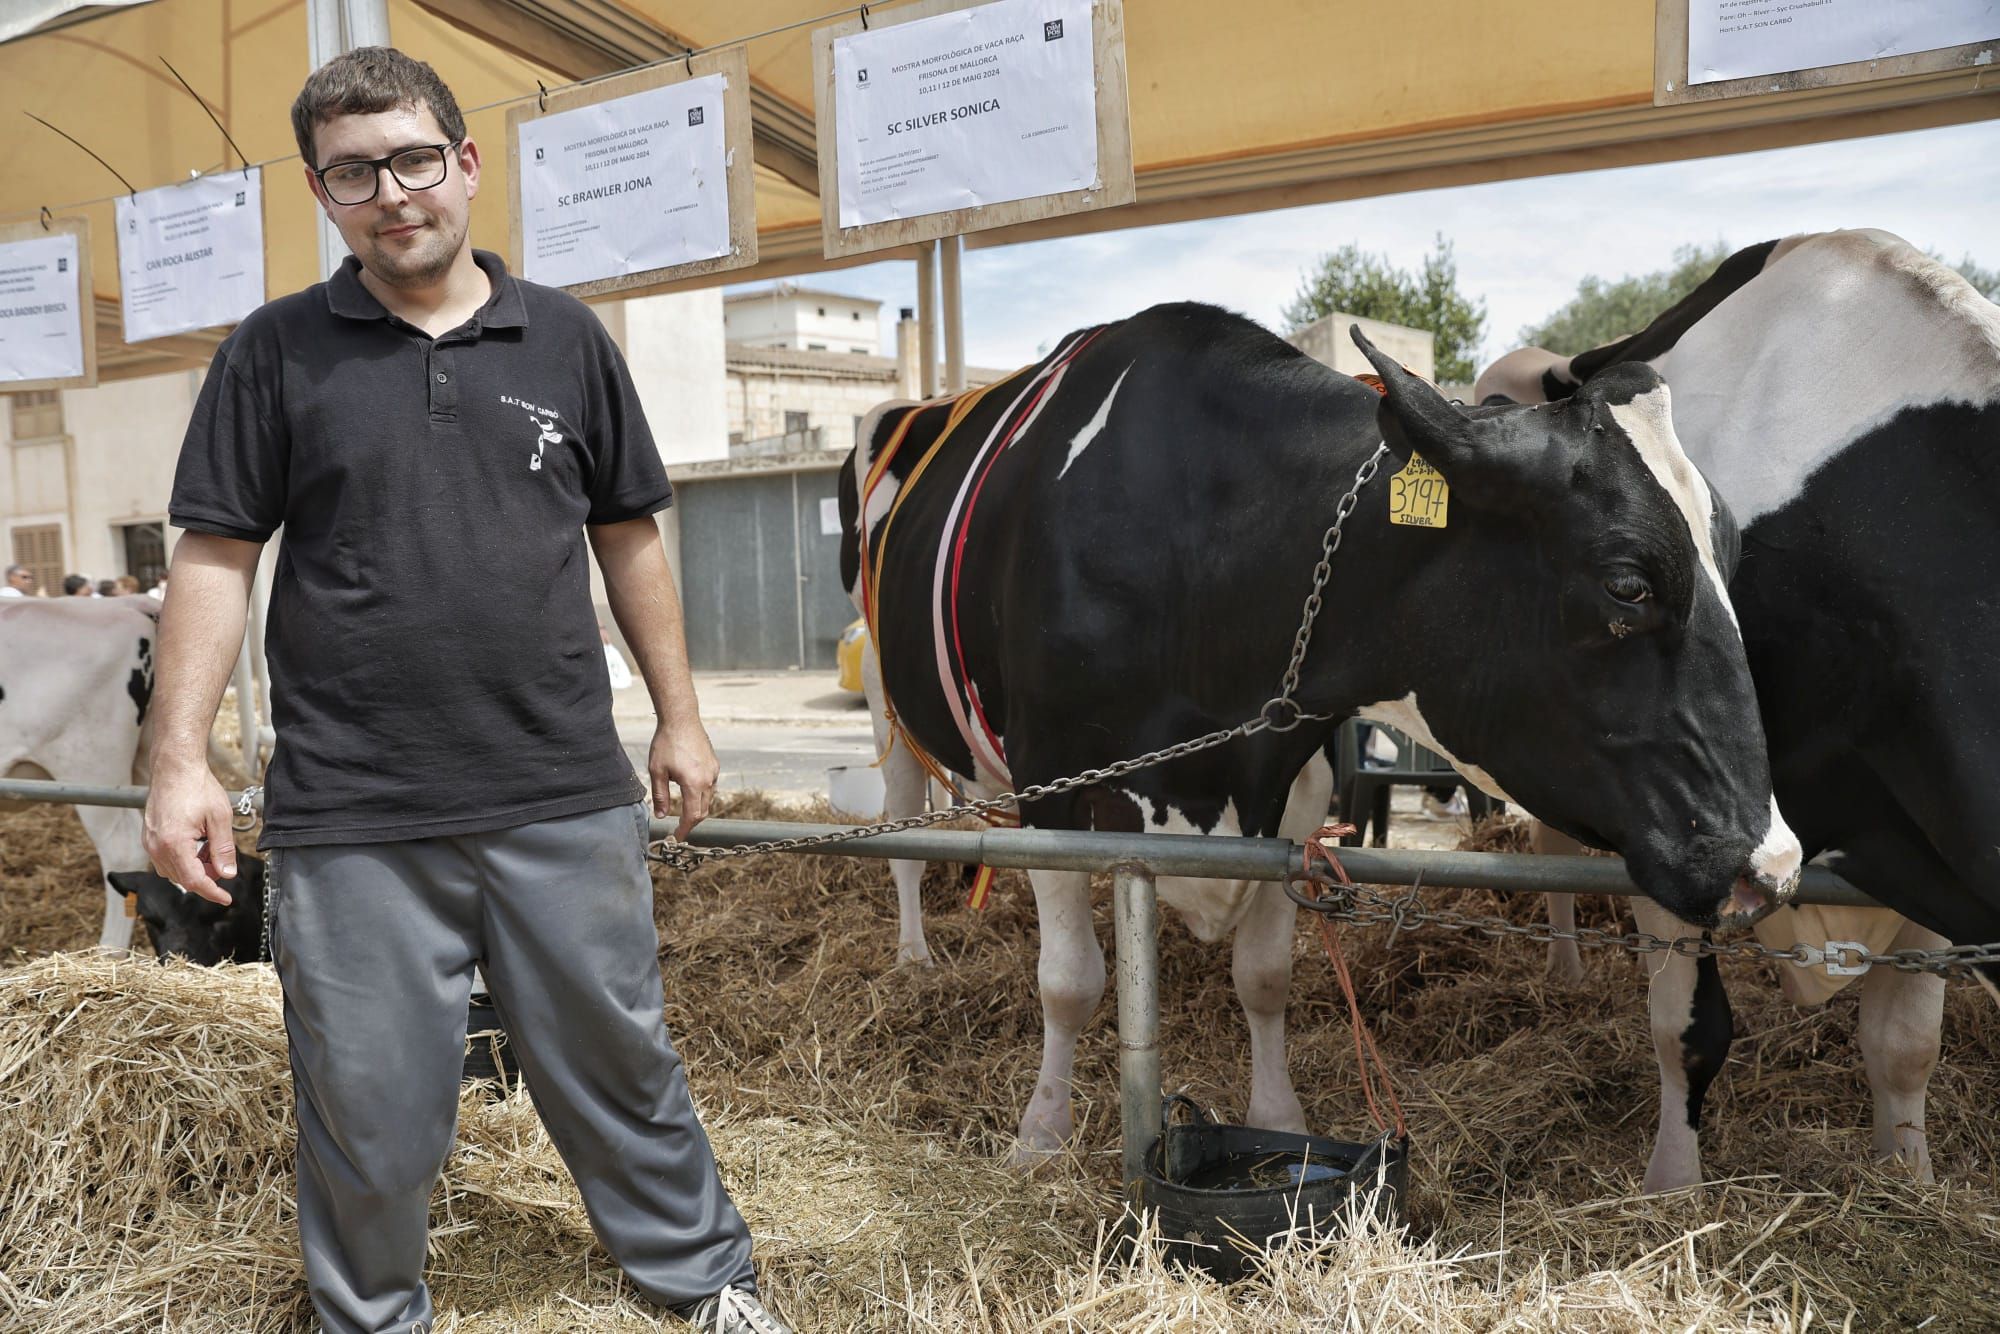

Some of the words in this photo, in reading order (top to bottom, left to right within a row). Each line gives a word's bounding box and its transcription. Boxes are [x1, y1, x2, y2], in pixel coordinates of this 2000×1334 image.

[1769, 16, 1793, 25] CARBÓ
[891, 61, 921, 74] MOSTRA
[921, 47, 973, 66] MORFOLÒGICA
[973, 44, 983, 52] DE
[984, 38, 1004, 50] VACA
[1005, 34, 1025, 45] RAÇA
[918, 68, 948, 80] FRISONA
[949, 64, 959, 73] DE
[959, 55, 998, 70] MALLORCA
[918, 85, 937, 95] 10,11
[942, 81, 950, 89] 12
[951, 78, 961, 86] DE
[962, 73, 982, 83] MAIG
[983, 68, 1000, 79] 2024
[887, 122, 903, 136] SC
[905, 111, 948, 131] SILVER
[950, 98, 1001, 120] SONICA
[563, 141, 587, 152] MOSTRA
[587, 130, 628, 145] MORFOLÒGICA
[629, 128, 637, 136] DE
[637, 124, 653, 134] VACA
[653, 120, 670, 129] RAÇA
[584, 149, 609, 159] FRISONA
[617, 138, 649, 151] MALLORCA
[603, 159, 611, 167] 12
[611, 157, 619, 165] DE
[619, 153, 636, 163] MAIG
[636, 150, 650, 159] 2024
[558, 196, 570, 207] SC
[572, 183, 622, 204] BRAWLER
[624, 176, 653, 192] JONA
[146, 260, 162, 271] CAN
[162, 254, 183, 267] ROCA
[184, 246, 214, 261] ALISTAR
[1391, 476, 1444, 518] 3197
